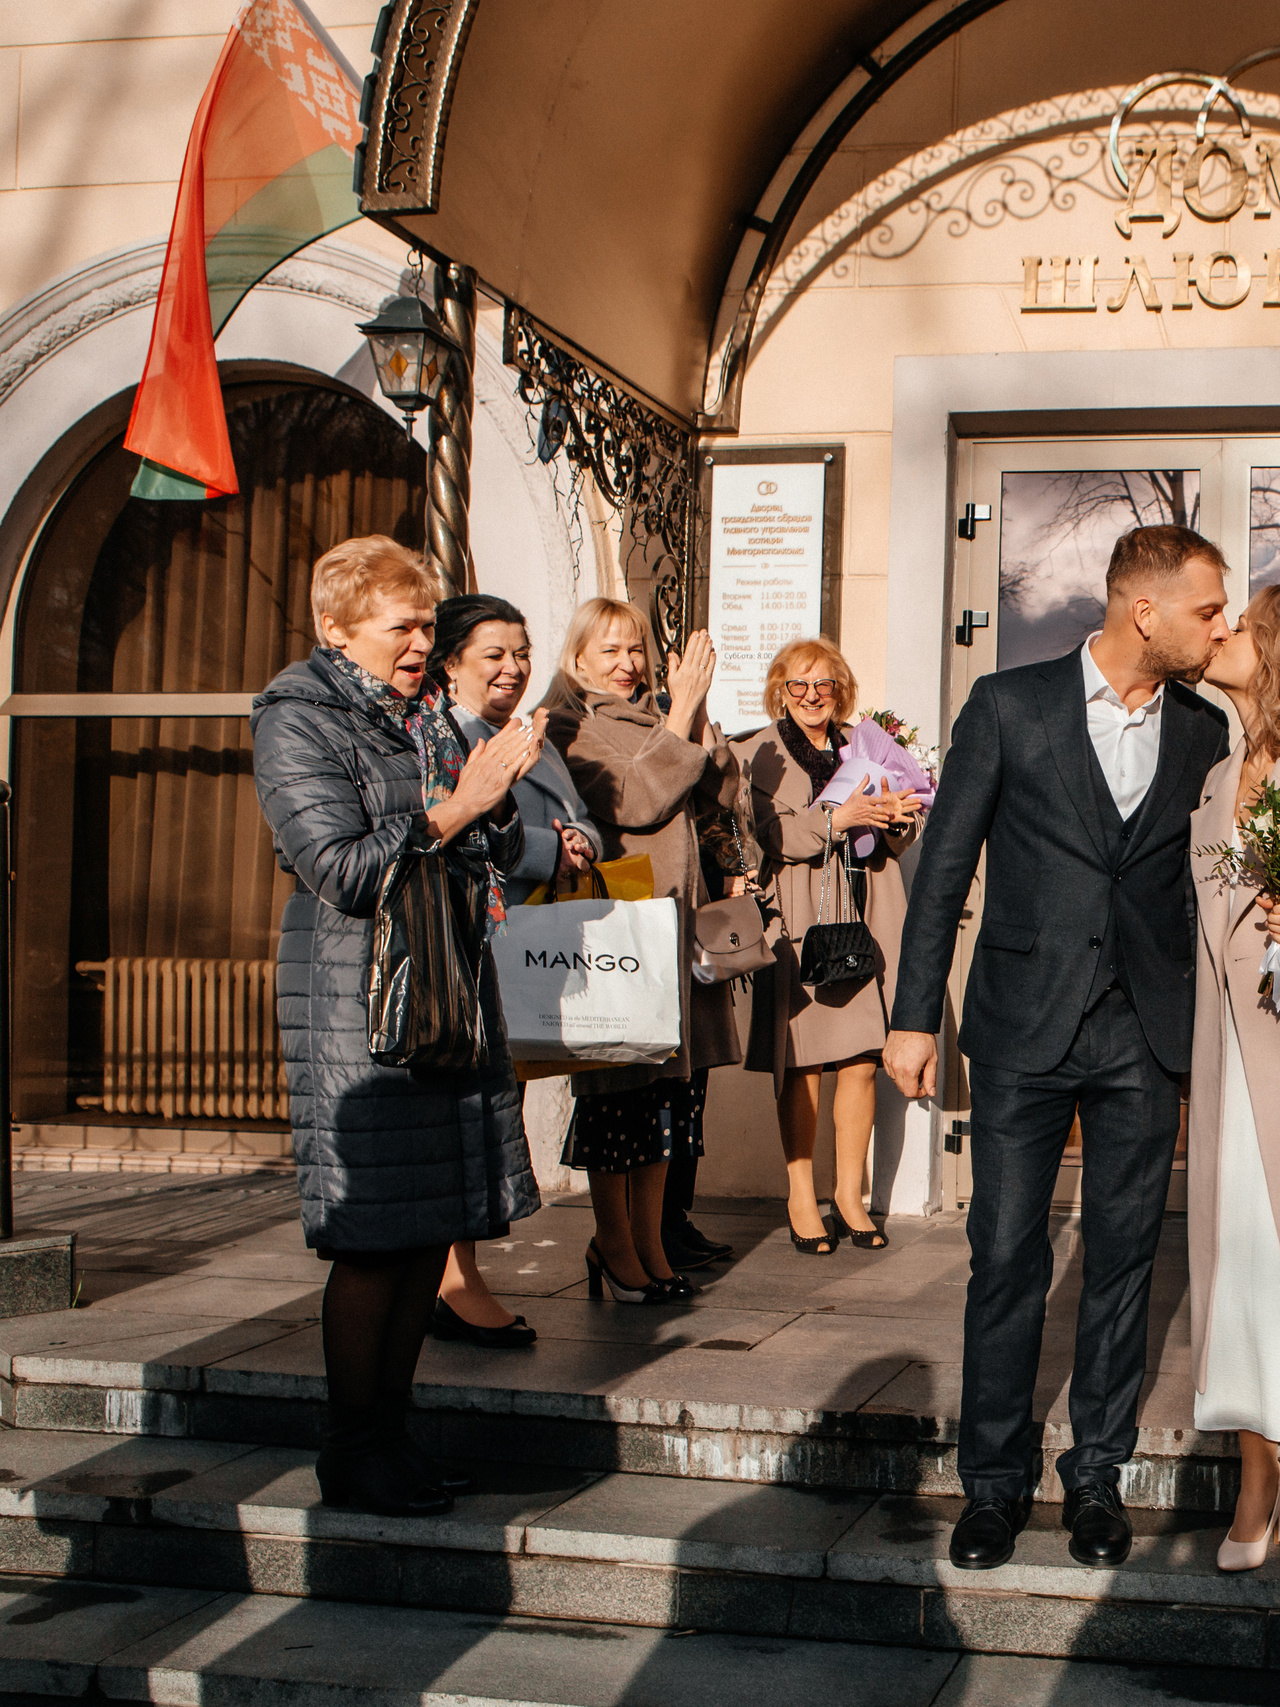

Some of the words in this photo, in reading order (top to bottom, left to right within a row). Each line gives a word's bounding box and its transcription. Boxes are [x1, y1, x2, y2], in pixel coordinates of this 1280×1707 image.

[750, 503, 783, 513] Дворец
[721, 515, 775, 525] гражданских
[776, 513, 813, 524] обрядов
[723, 526, 759, 534] главного
[761, 525, 810, 536] управления
[722, 592, 752, 601] Вторник
[722, 601, 743, 610] Обед
[721, 624, 747, 633] Среда
[721, 634, 750, 642] Четверг
[720, 643, 751, 652] Пятница
[525, 949, 640, 973] MANGO
